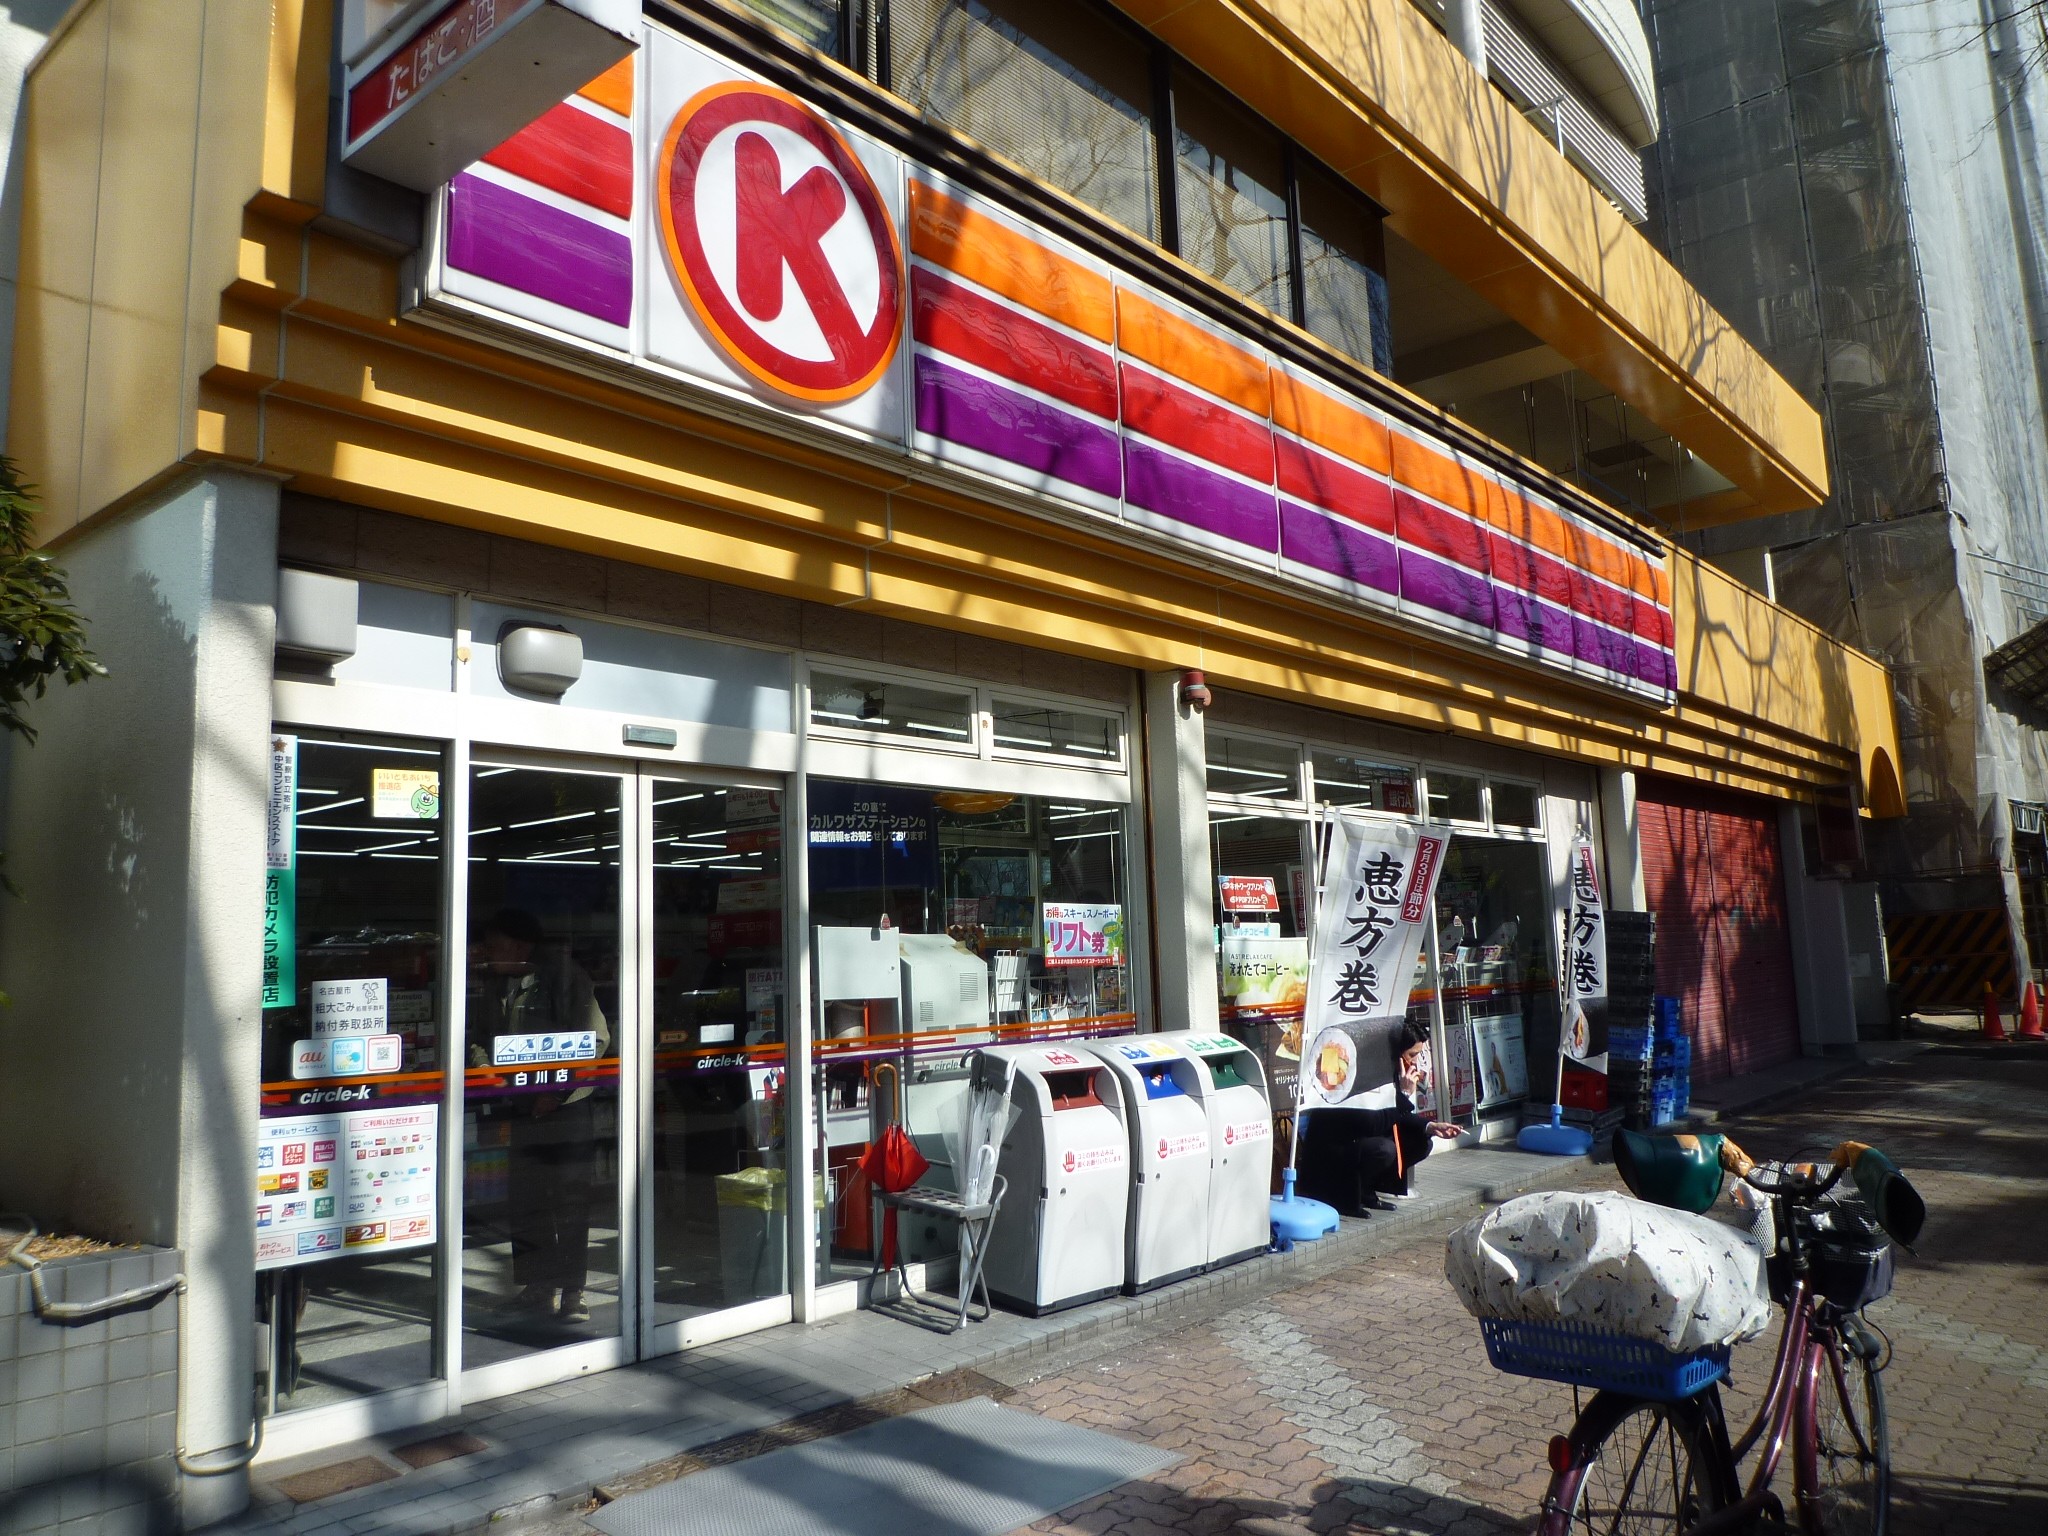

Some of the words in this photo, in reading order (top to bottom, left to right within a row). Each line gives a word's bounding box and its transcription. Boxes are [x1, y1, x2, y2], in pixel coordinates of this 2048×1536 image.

[271, 755, 284, 846] 中区コンビニエンスストア
[810, 814, 926, 829] カルワザステーションの
[1404, 841, 1436, 919] 2月3日は節分
[1049, 921, 1105, 953] リフト券
[1328, 851, 1404, 1014] 恵方巻
[319, 986, 352, 996] 名古屋市
[315, 1017, 384, 1033] 納付券取扱所
[299, 1051, 326, 1063] au
[697, 1053, 745, 1069] circle-k
[515, 1068, 569, 1086] 白川店
[299, 1084, 372, 1105] circle-k
[363, 1115, 421, 1128] ご利用いただけます
[271, 1125, 319, 1137] 便利なサービス
